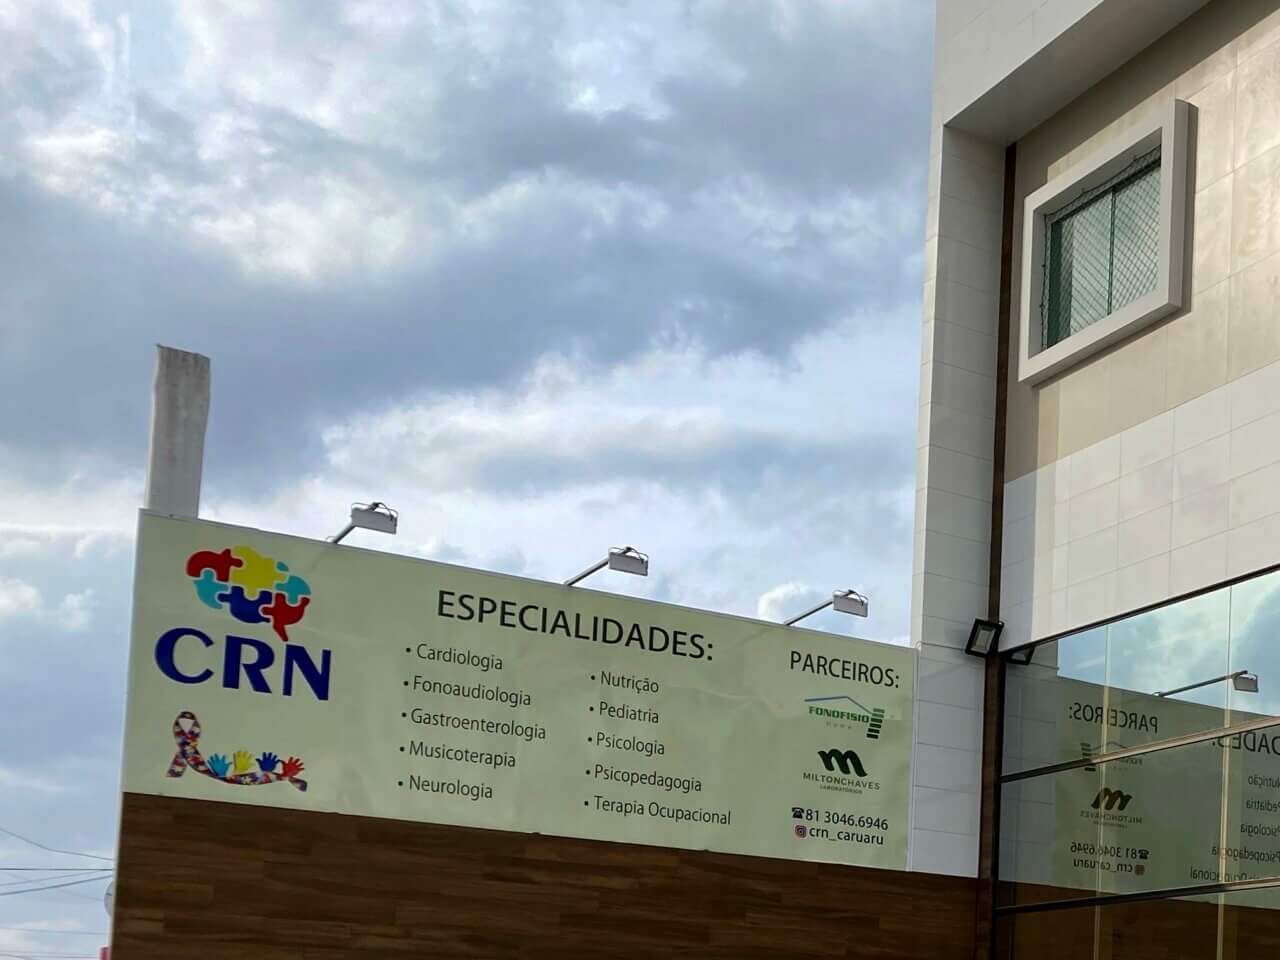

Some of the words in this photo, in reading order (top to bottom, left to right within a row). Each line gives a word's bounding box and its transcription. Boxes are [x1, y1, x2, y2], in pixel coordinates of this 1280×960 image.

[437, 590, 714, 661] ESPECIALIDADES:
[154, 627, 332, 701] CRN
[416, 643, 503, 671] Cardiologia
[790, 650, 900, 689] PARCEIROS:
[412, 675, 532, 708] Fonoaudiologia
[600, 671, 660, 695] Nutrição
[410, 708, 547, 741] Gastroenterologia
[599, 702, 660, 724] Pediatria
[808, 706, 870, 724] FONOFISIO
[409, 741, 517, 769] Musicoterapia
[596, 732, 665, 756] Psicologia
[409, 776, 494, 801] Neurologia
[594, 764, 702, 794] Psicopedagogia
[802, 772, 881, 791] MILTONCHAVES
[594, 796, 645, 817] Terapia
[648, 802, 732, 825] Ocupacional
[805, 808, 820, 823] 81
[824, 810, 889, 831] 3046.6946
[809, 827, 884, 845] crn_caruaru
